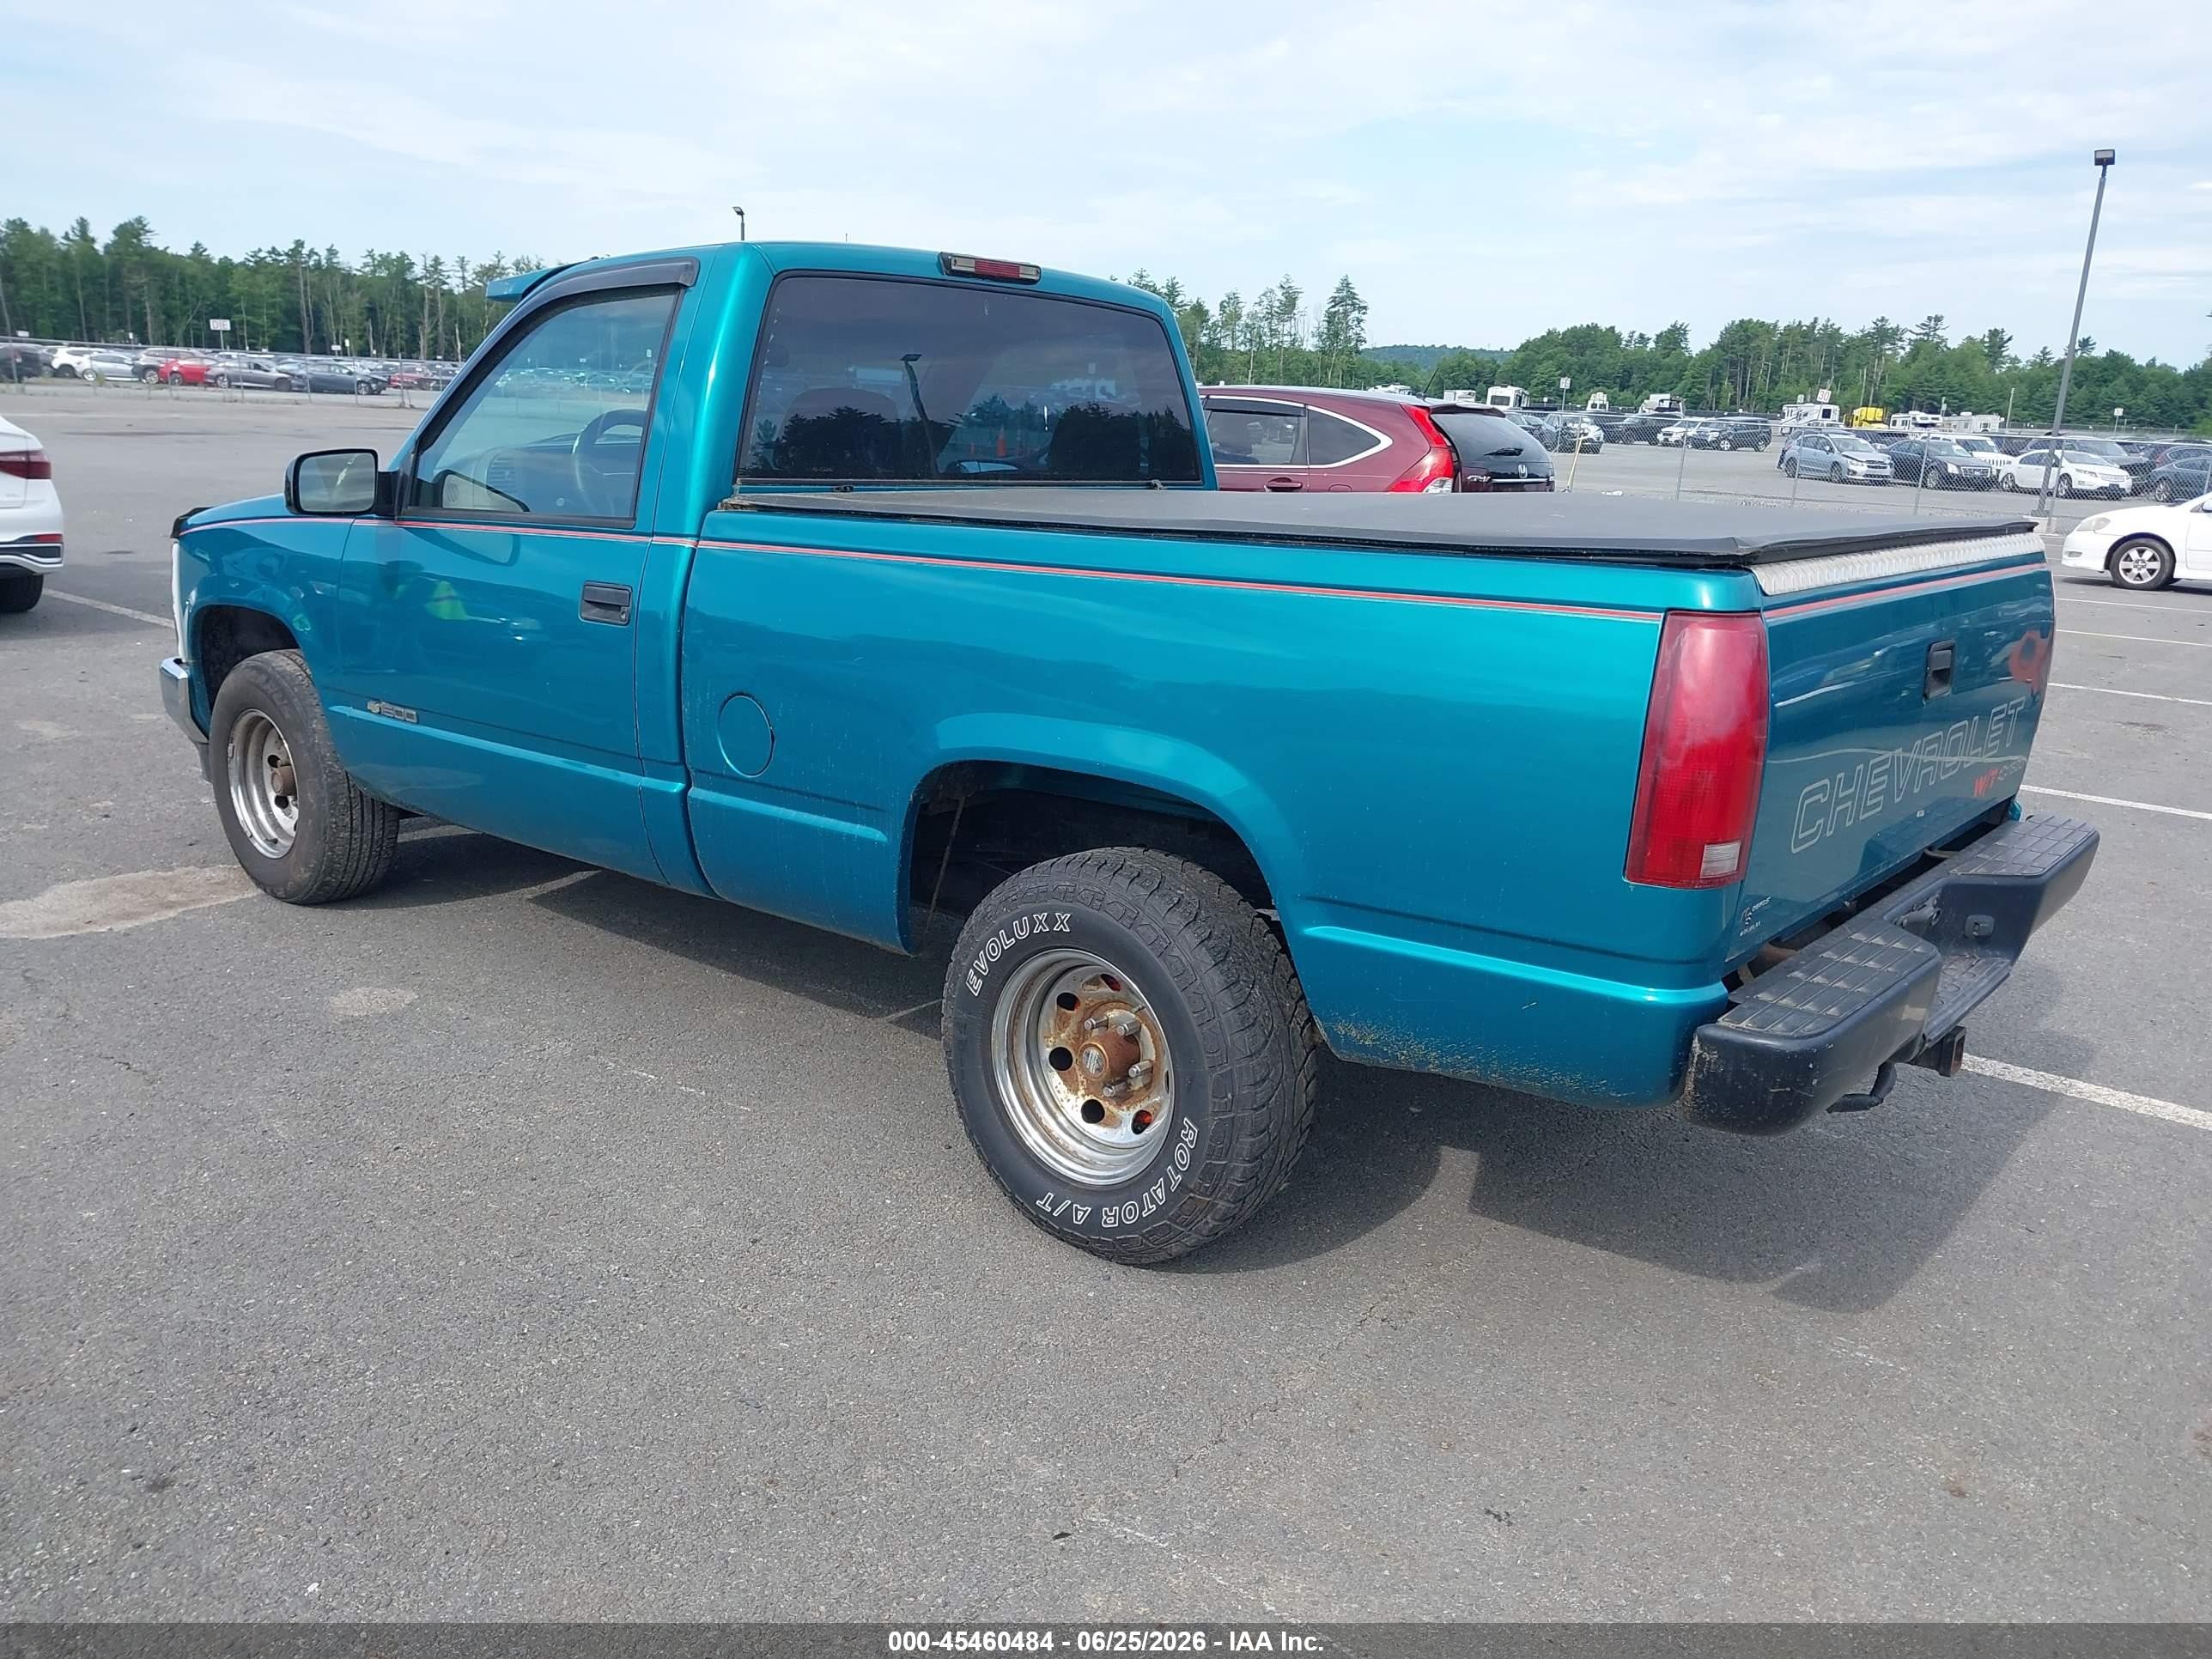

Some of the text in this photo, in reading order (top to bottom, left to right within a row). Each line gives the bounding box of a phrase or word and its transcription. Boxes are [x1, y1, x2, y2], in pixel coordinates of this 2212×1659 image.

[1818, 390, 1830, 401] 30
[1790, 696, 2027, 854] CHEVROLET
[965, 912, 1072, 997] EVOLUXX
[1036, 1117, 1199, 1228] ROTATOR A/T
